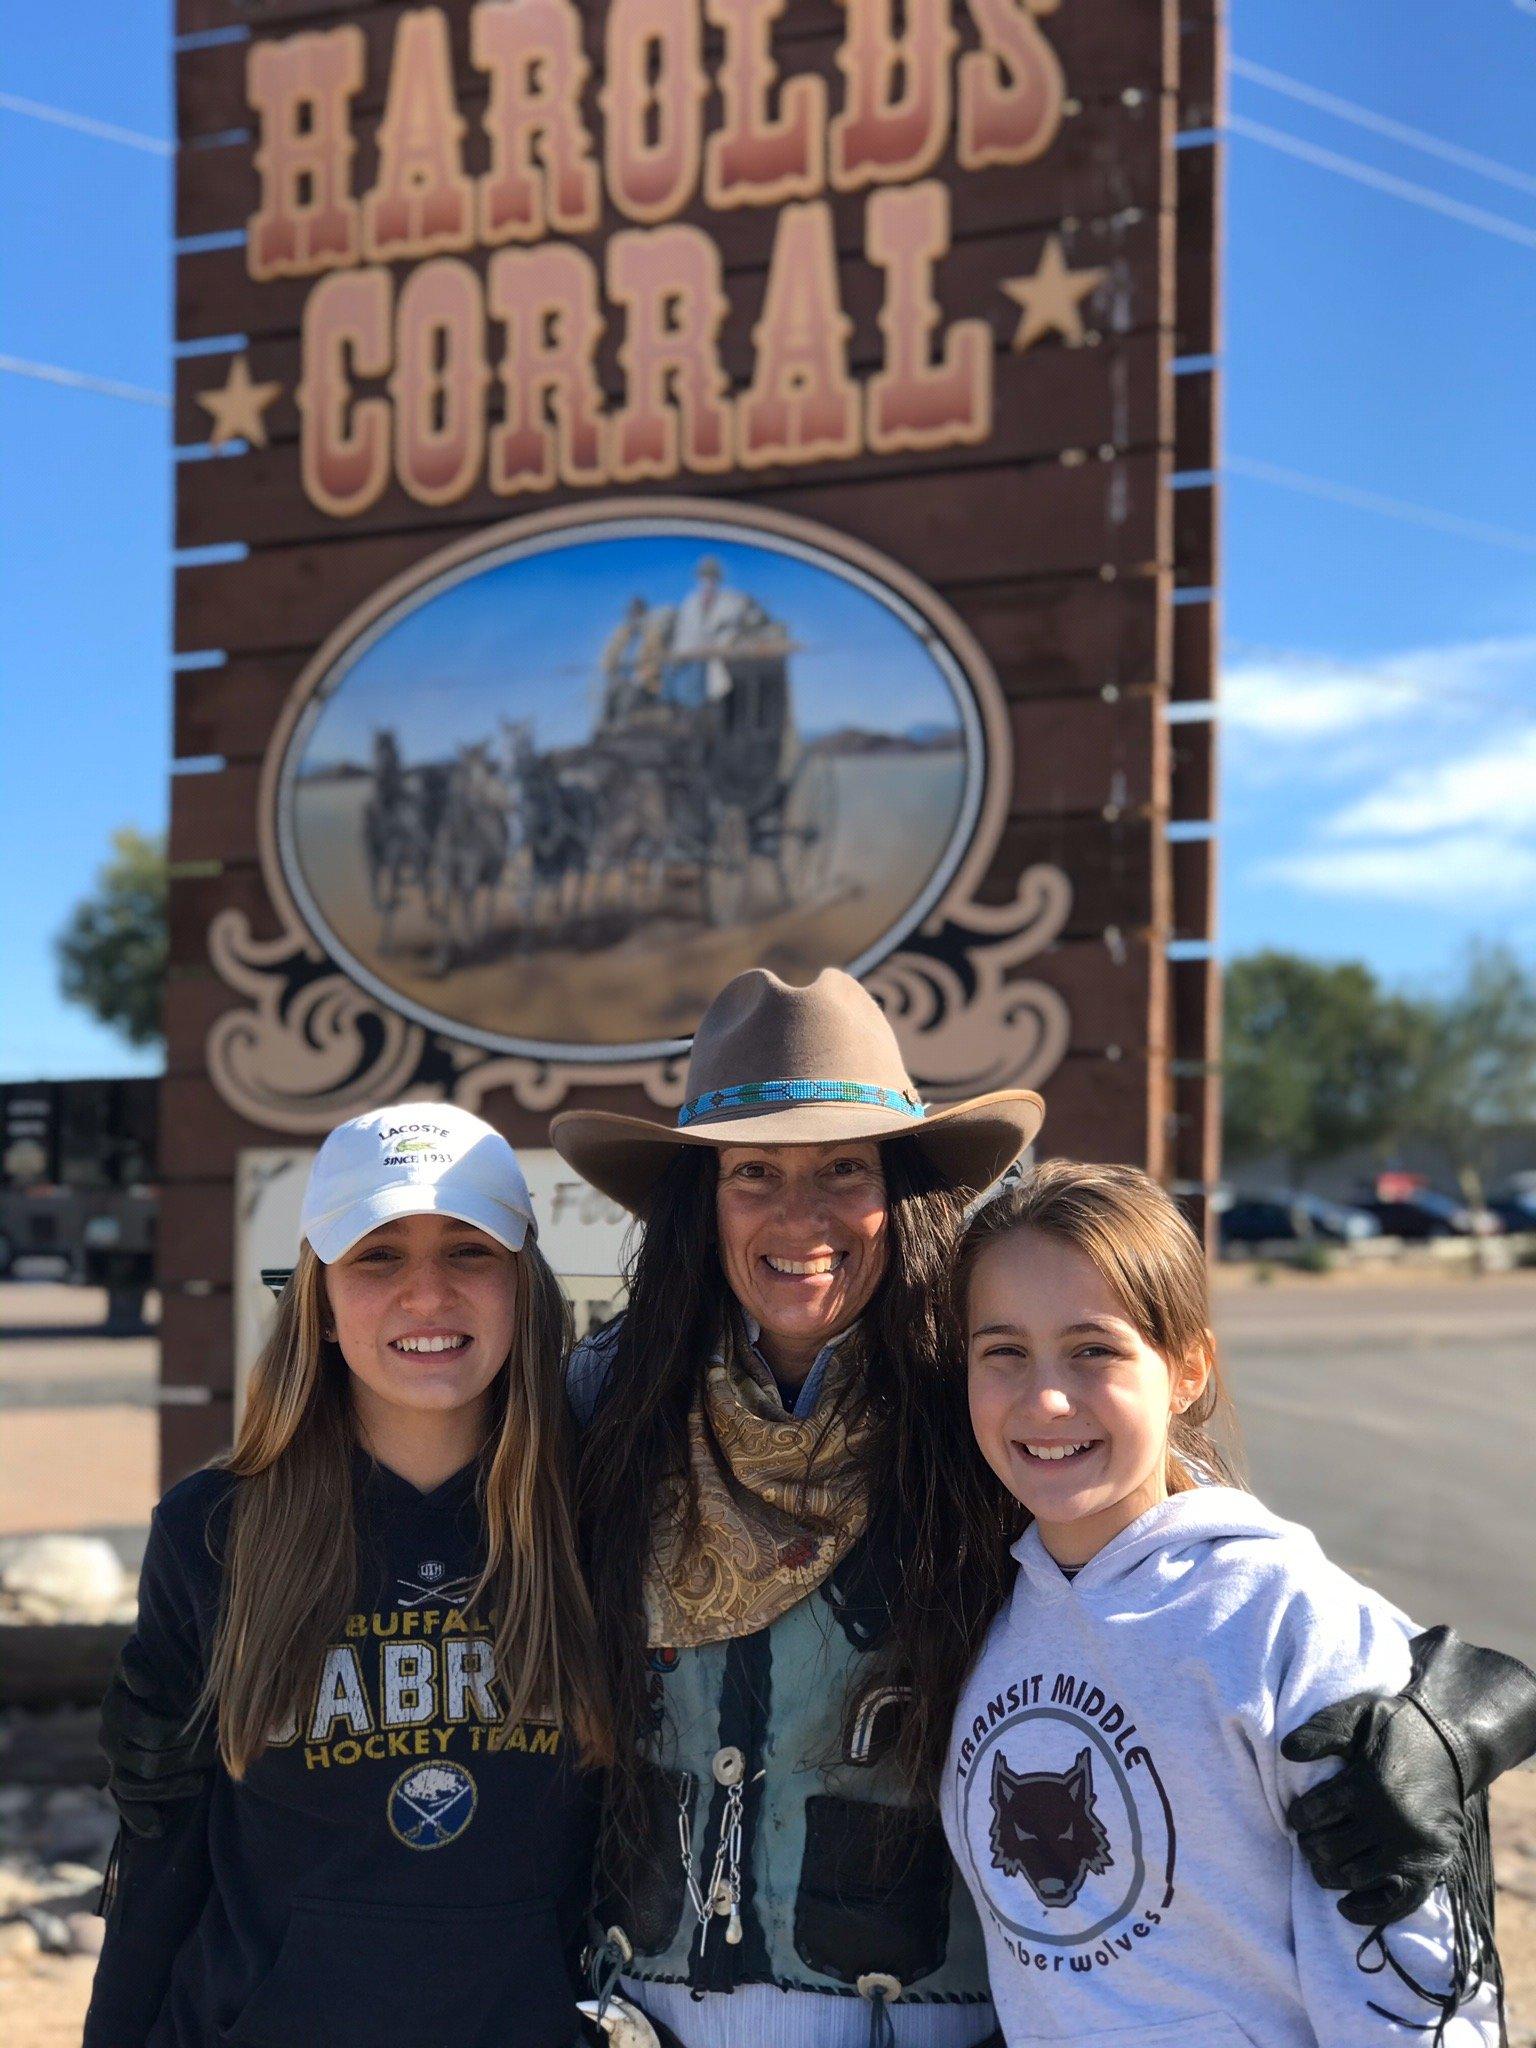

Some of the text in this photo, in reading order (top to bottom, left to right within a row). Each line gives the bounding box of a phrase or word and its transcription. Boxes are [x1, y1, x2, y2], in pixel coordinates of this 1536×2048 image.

[297, 181, 994, 517] CORRAL
[378, 1124, 451, 1141] LACOSTE
[383, 1153, 453, 1166] SINCE 1933
[304, 1725, 561, 1770] HOCKEY TEAM
[956, 1672, 1148, 1779] TRANSIT MIDDLE
